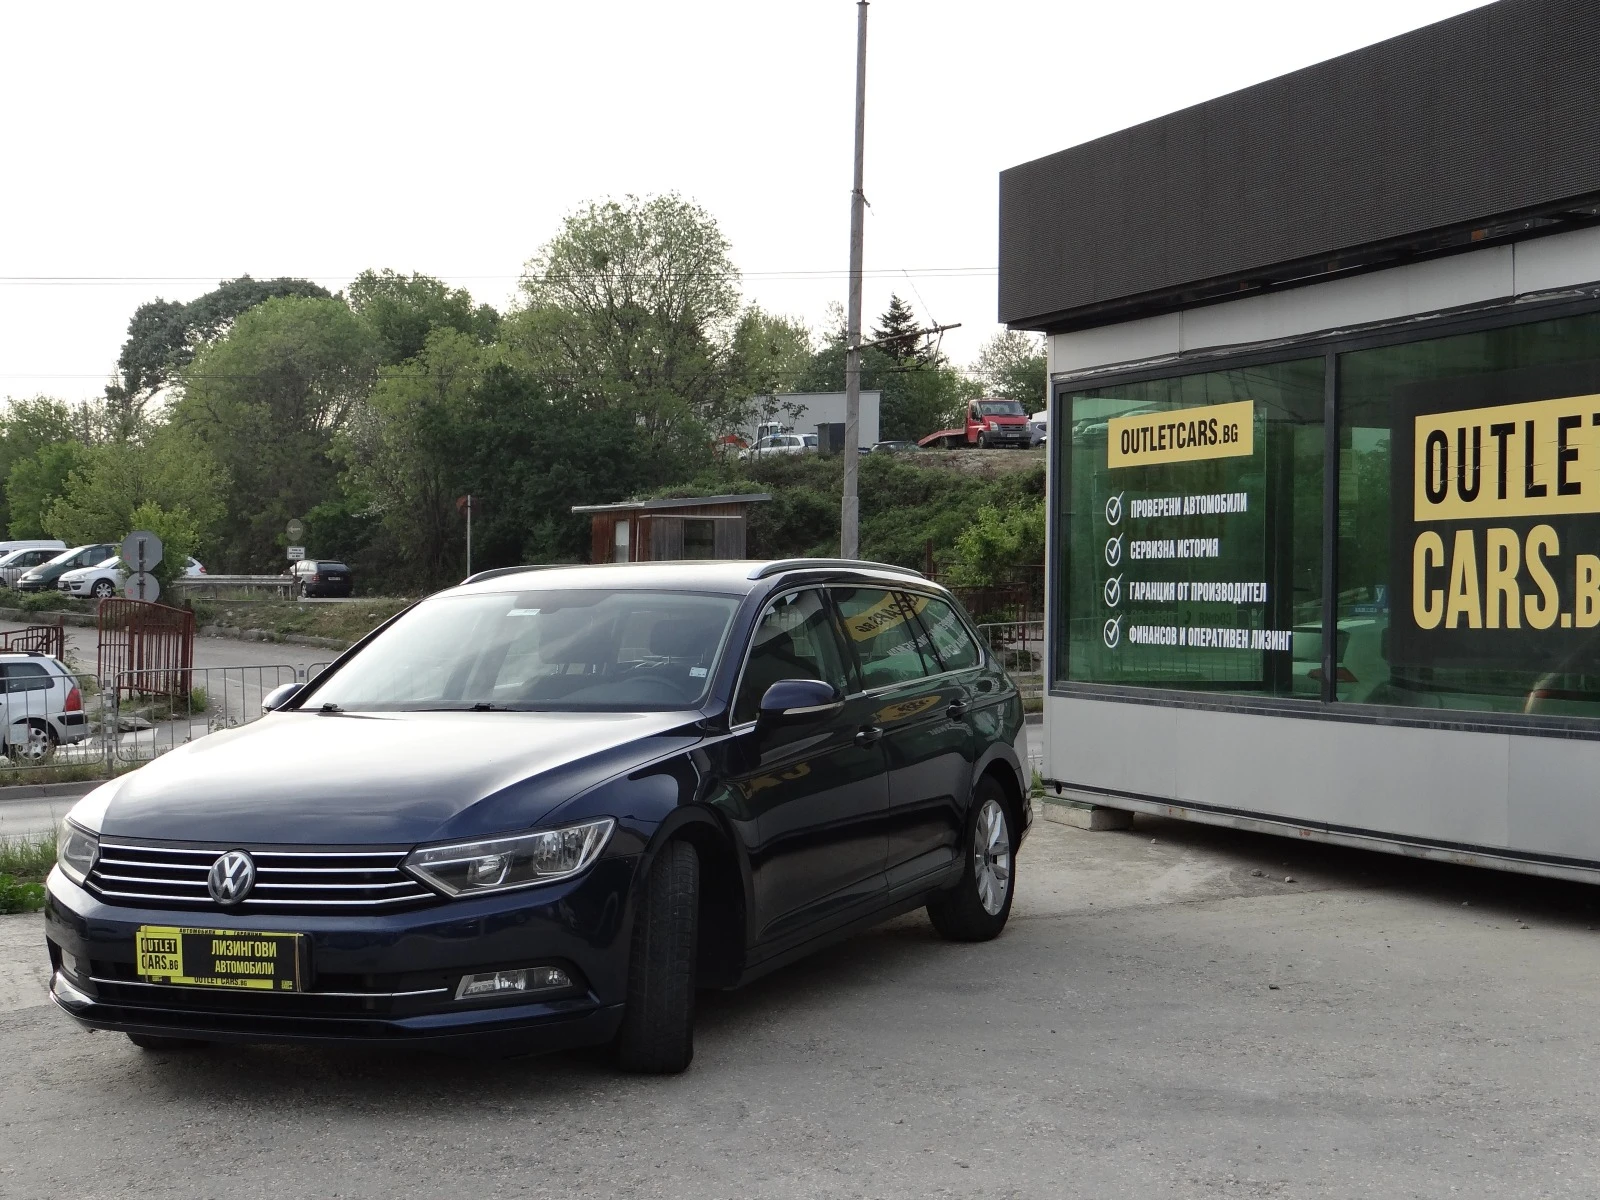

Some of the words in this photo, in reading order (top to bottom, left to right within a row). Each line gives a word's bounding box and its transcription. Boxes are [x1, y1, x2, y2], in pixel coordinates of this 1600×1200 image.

[1121, 418, 1238, 455] OUTLETCARS.BG
[1130, 497, 1181, 518] ПРОВЕРЕНИ
[1183, 492, 1247, 515] АВТОМОБИЛИ
[1130, 540, 1175, 559] СЕРВИЗНА
[1177, 538, 1219, 558] ИСТОРИЯ
[1129, 581, 1175, 602] ГАРАНЦИЯ
[1177, 582, 1189, 601] ОТ
[1191, 582, 1267, 604] ПРОИЗВОДИТЕЛ
[1129, 625, 1177, 645] ФИНАНСОВ
[1179, 626, 1186, 646] И
[1188, 627, 1248, 649] ОПЕРАТИВЕН
[1250, 629, 1292, 651] ЛИЗИНГ
[142, 939, 176, 952] OUTLET
[211, 940, 277, 957] ЛИЗИНГОВИ
[215, 959, 275, 974] АВТОМОБИЛИ
